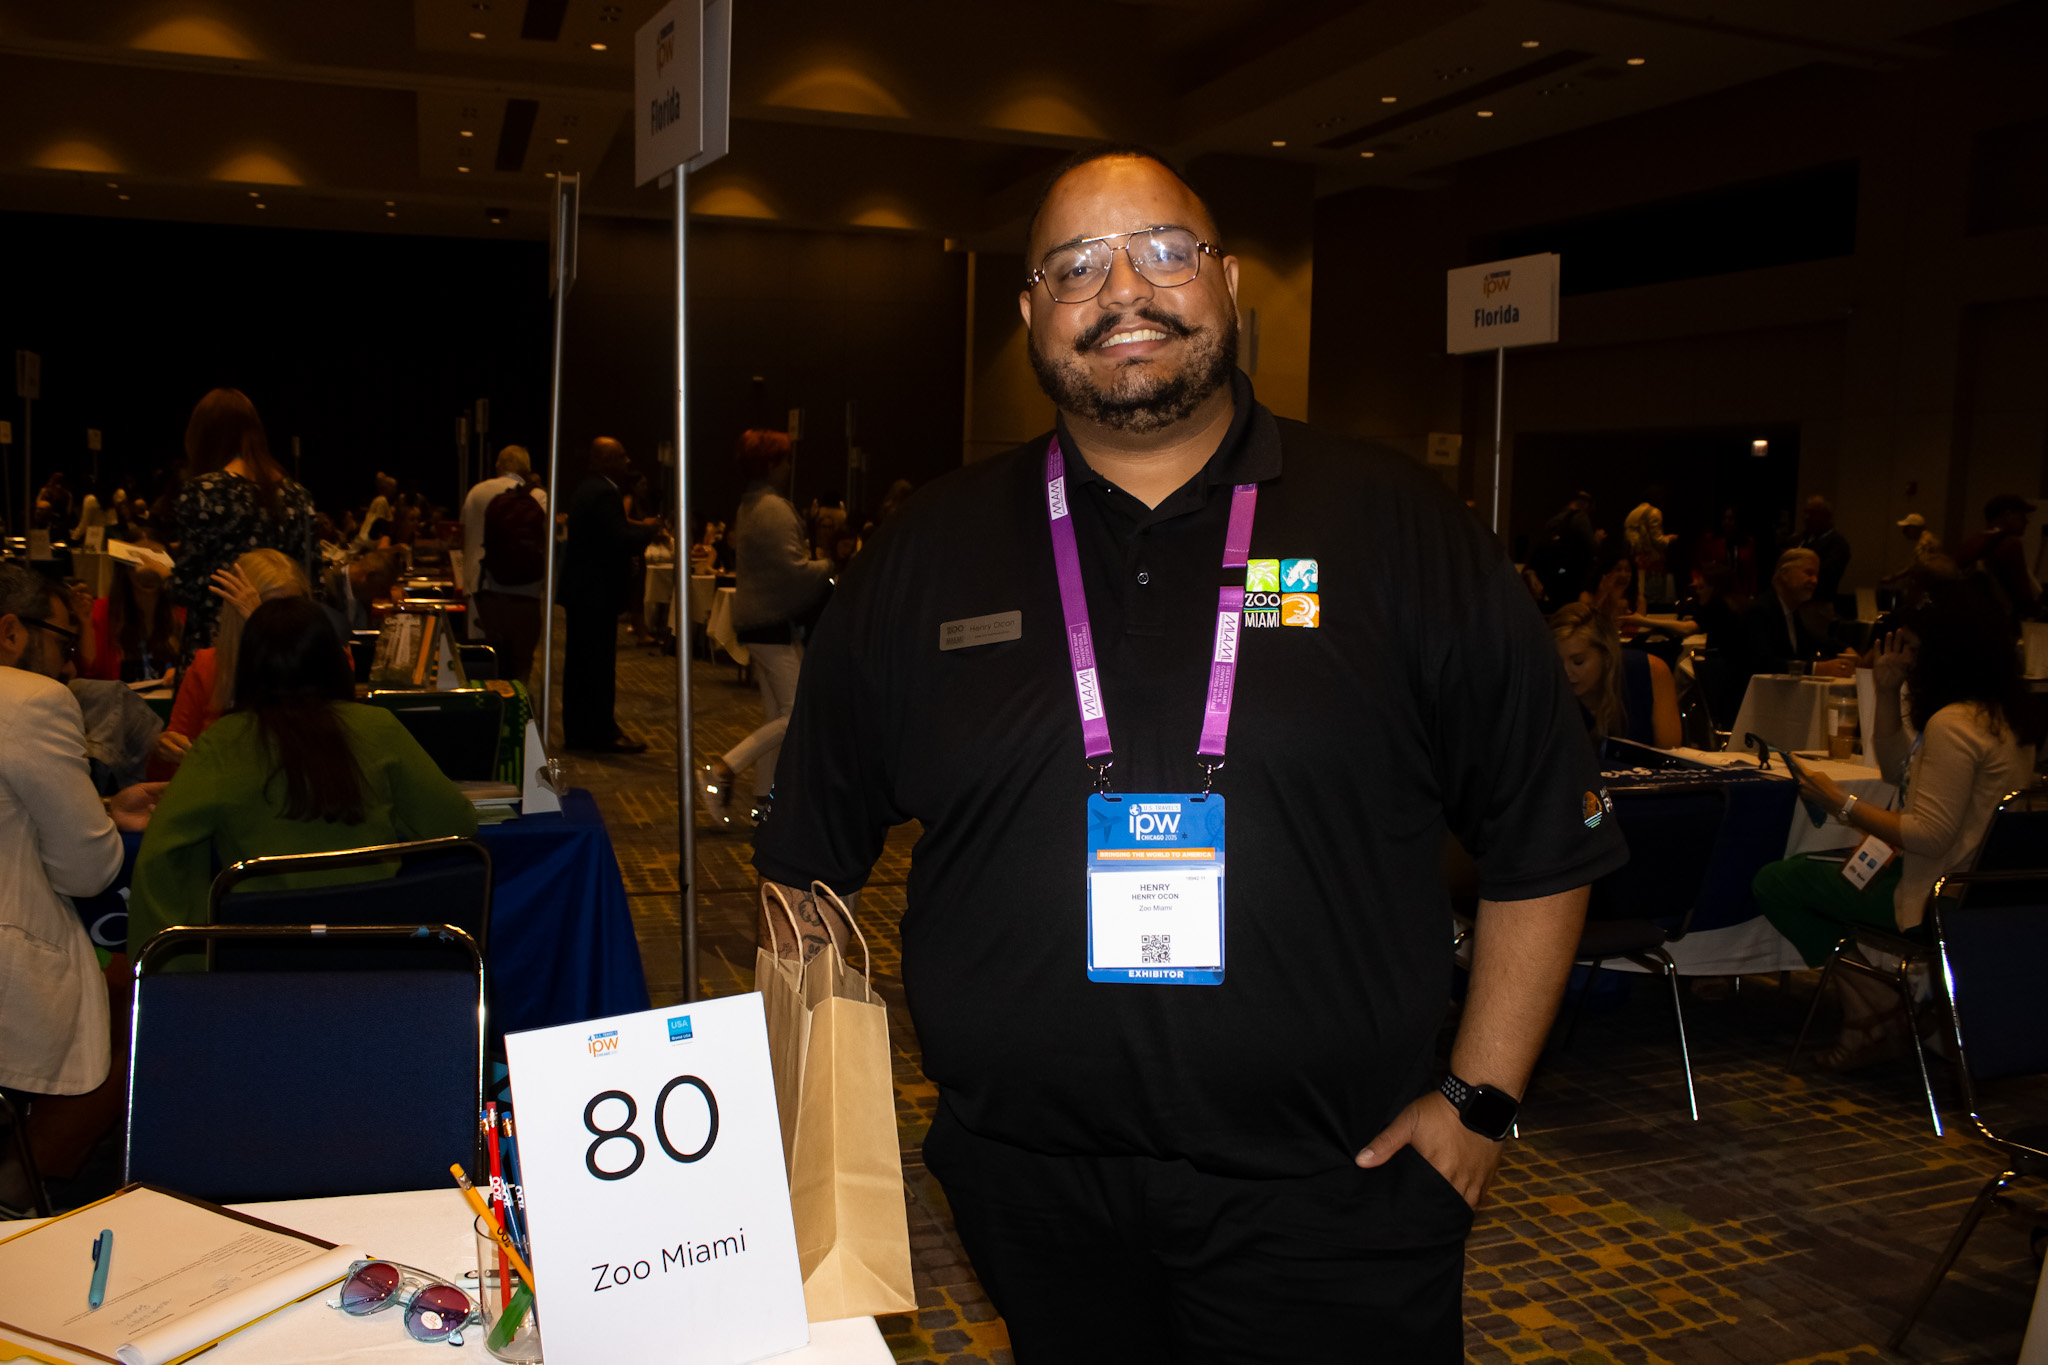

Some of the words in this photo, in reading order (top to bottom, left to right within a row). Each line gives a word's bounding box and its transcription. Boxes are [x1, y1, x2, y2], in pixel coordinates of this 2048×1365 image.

[651, 86, 681, 136] Florida
[1475, 305, 1520, 328] Florida
[1244, 593, 1280, 607] ZOO
[970, 623, 991, 632] Henry
[994, 620, 1015, 629] Ocon
[1244, 612, 1280, 628] MIAMI
[1221, 614, 1236, 661] MIAMI
[1079, 670, 1097, 716] MIAMI
[1171, 850, 1181, 858] TO
[1181, 850, 1212, 858] AMERICA
[1128, 969, 1184, 979] EXHIBITOR
[671, 1020, 688, 1029] USA
[588, 1036, 619, 1058] ipw
[583, 1074, 720, 1181] 80
[492, 1176, 503, 1202] ZOO
[591, 1260, 651, 1292] Zoo
[661, 1228, 746, 1273] Miami
